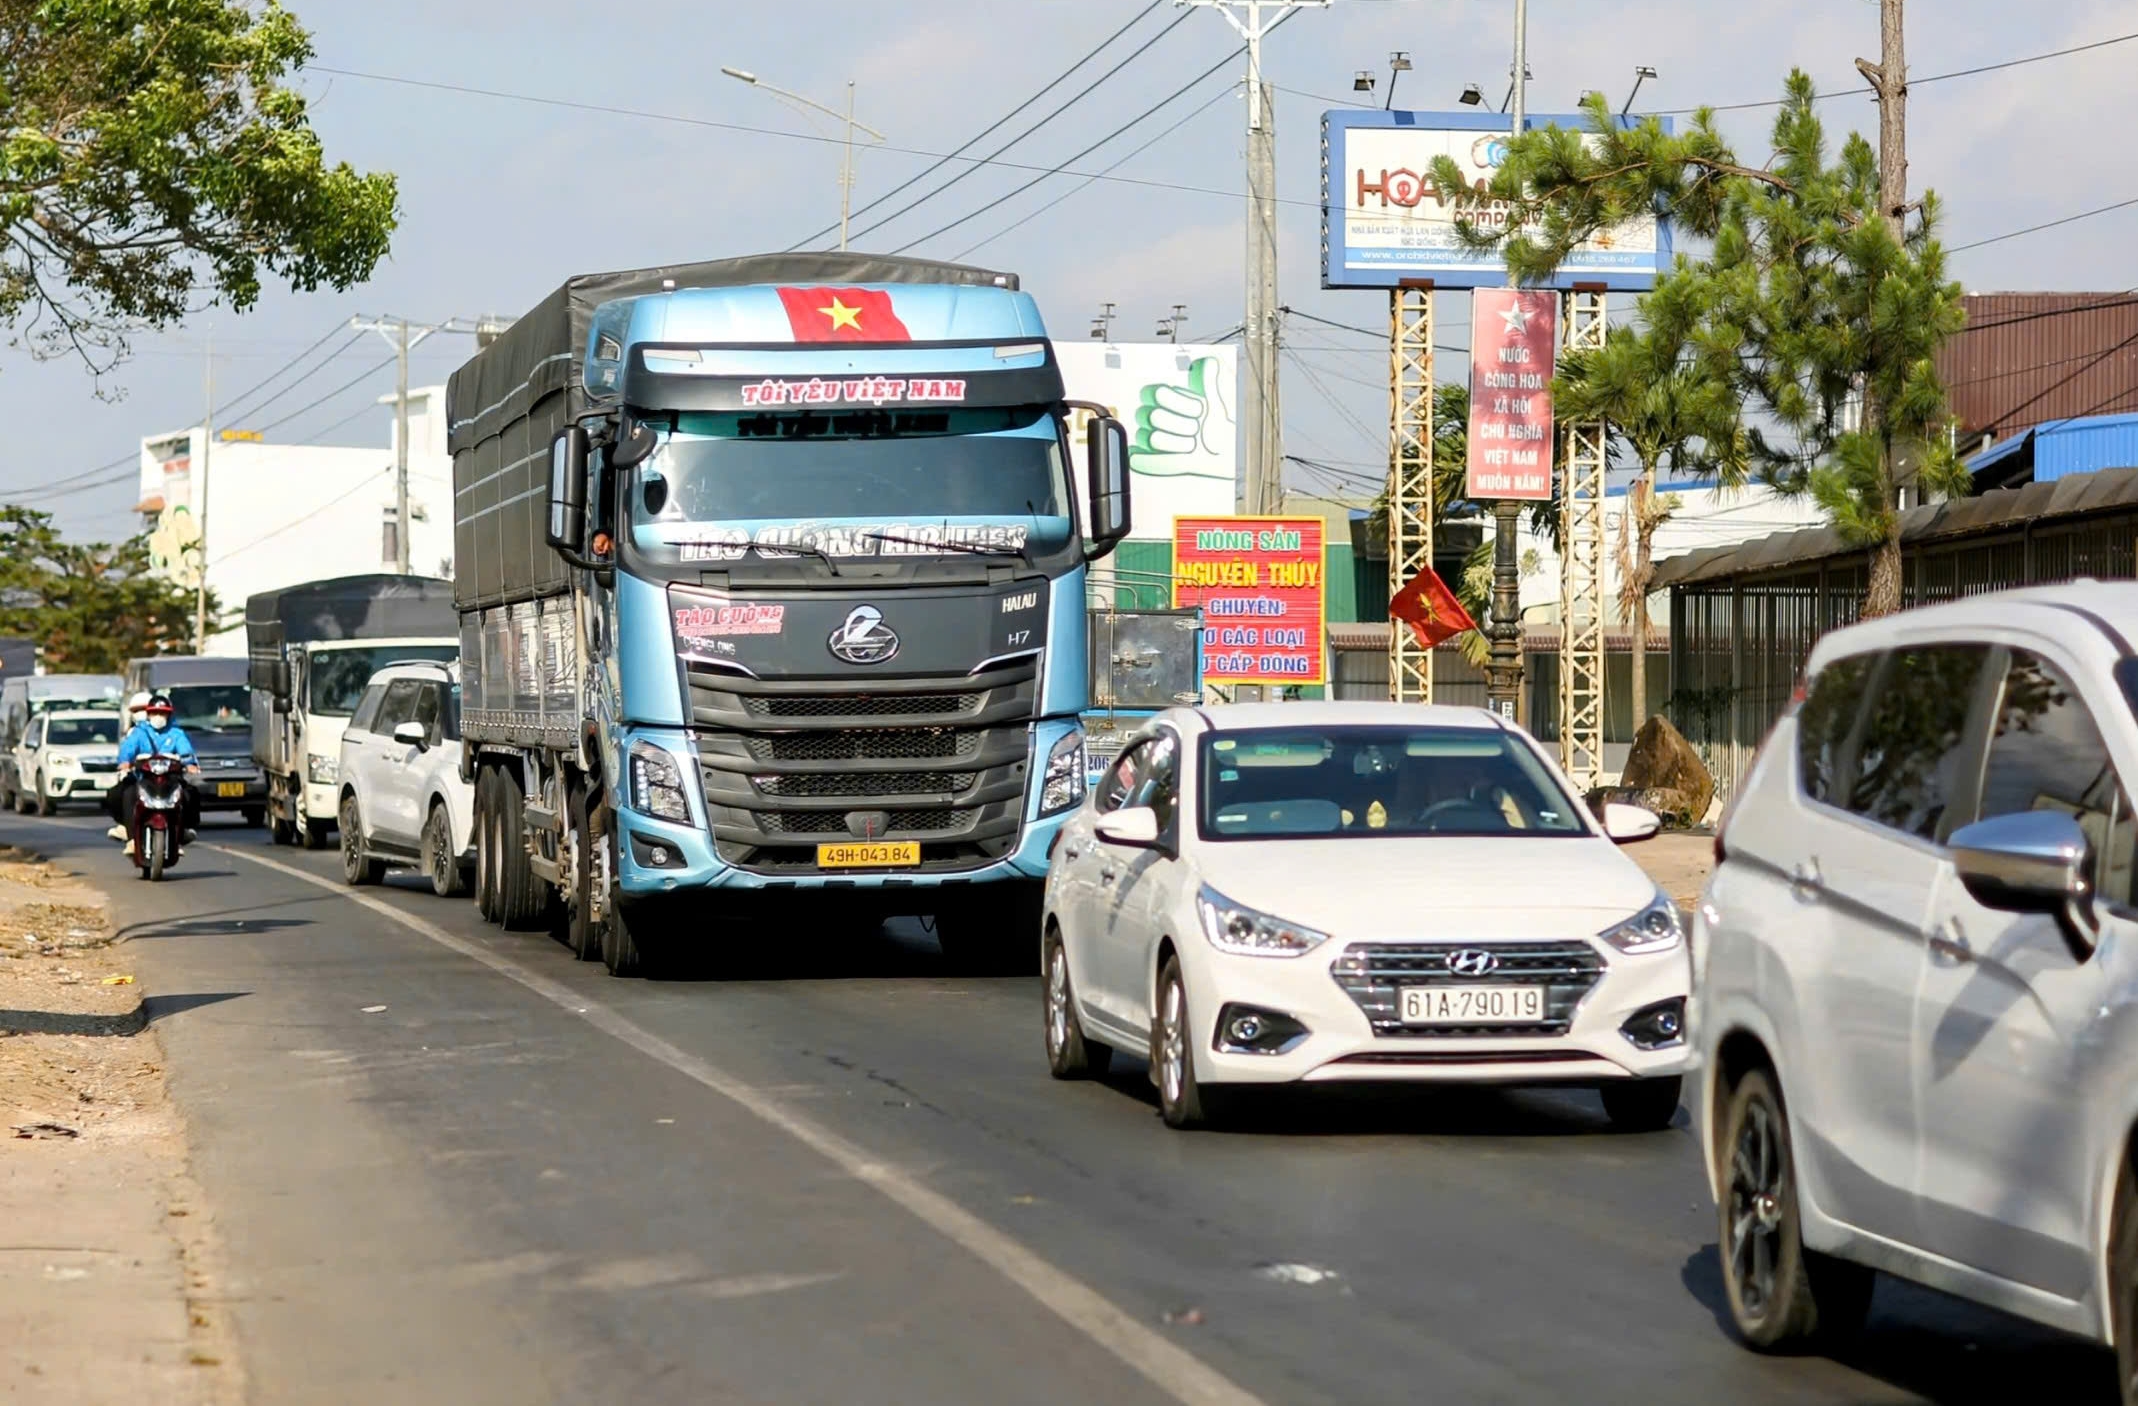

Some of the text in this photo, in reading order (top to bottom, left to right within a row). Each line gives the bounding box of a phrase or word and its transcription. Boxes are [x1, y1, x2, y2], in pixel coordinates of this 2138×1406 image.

[788, 378, 841, 404] YÊU
[907, 379, 966, 401] NAM
[1512, 450, 1538, 465] NAM
[1197, 525, 1301, 550] NÔNG SẢN
[1008, 630, 1030, 646] H7
[1223, 626, 1257, 646] CÁC
[1265, 628, 1305, 650] LOẠI
[1217, 651, 1254, 672] CẤP
[827, 848, 910, 862] 49H-043.84
